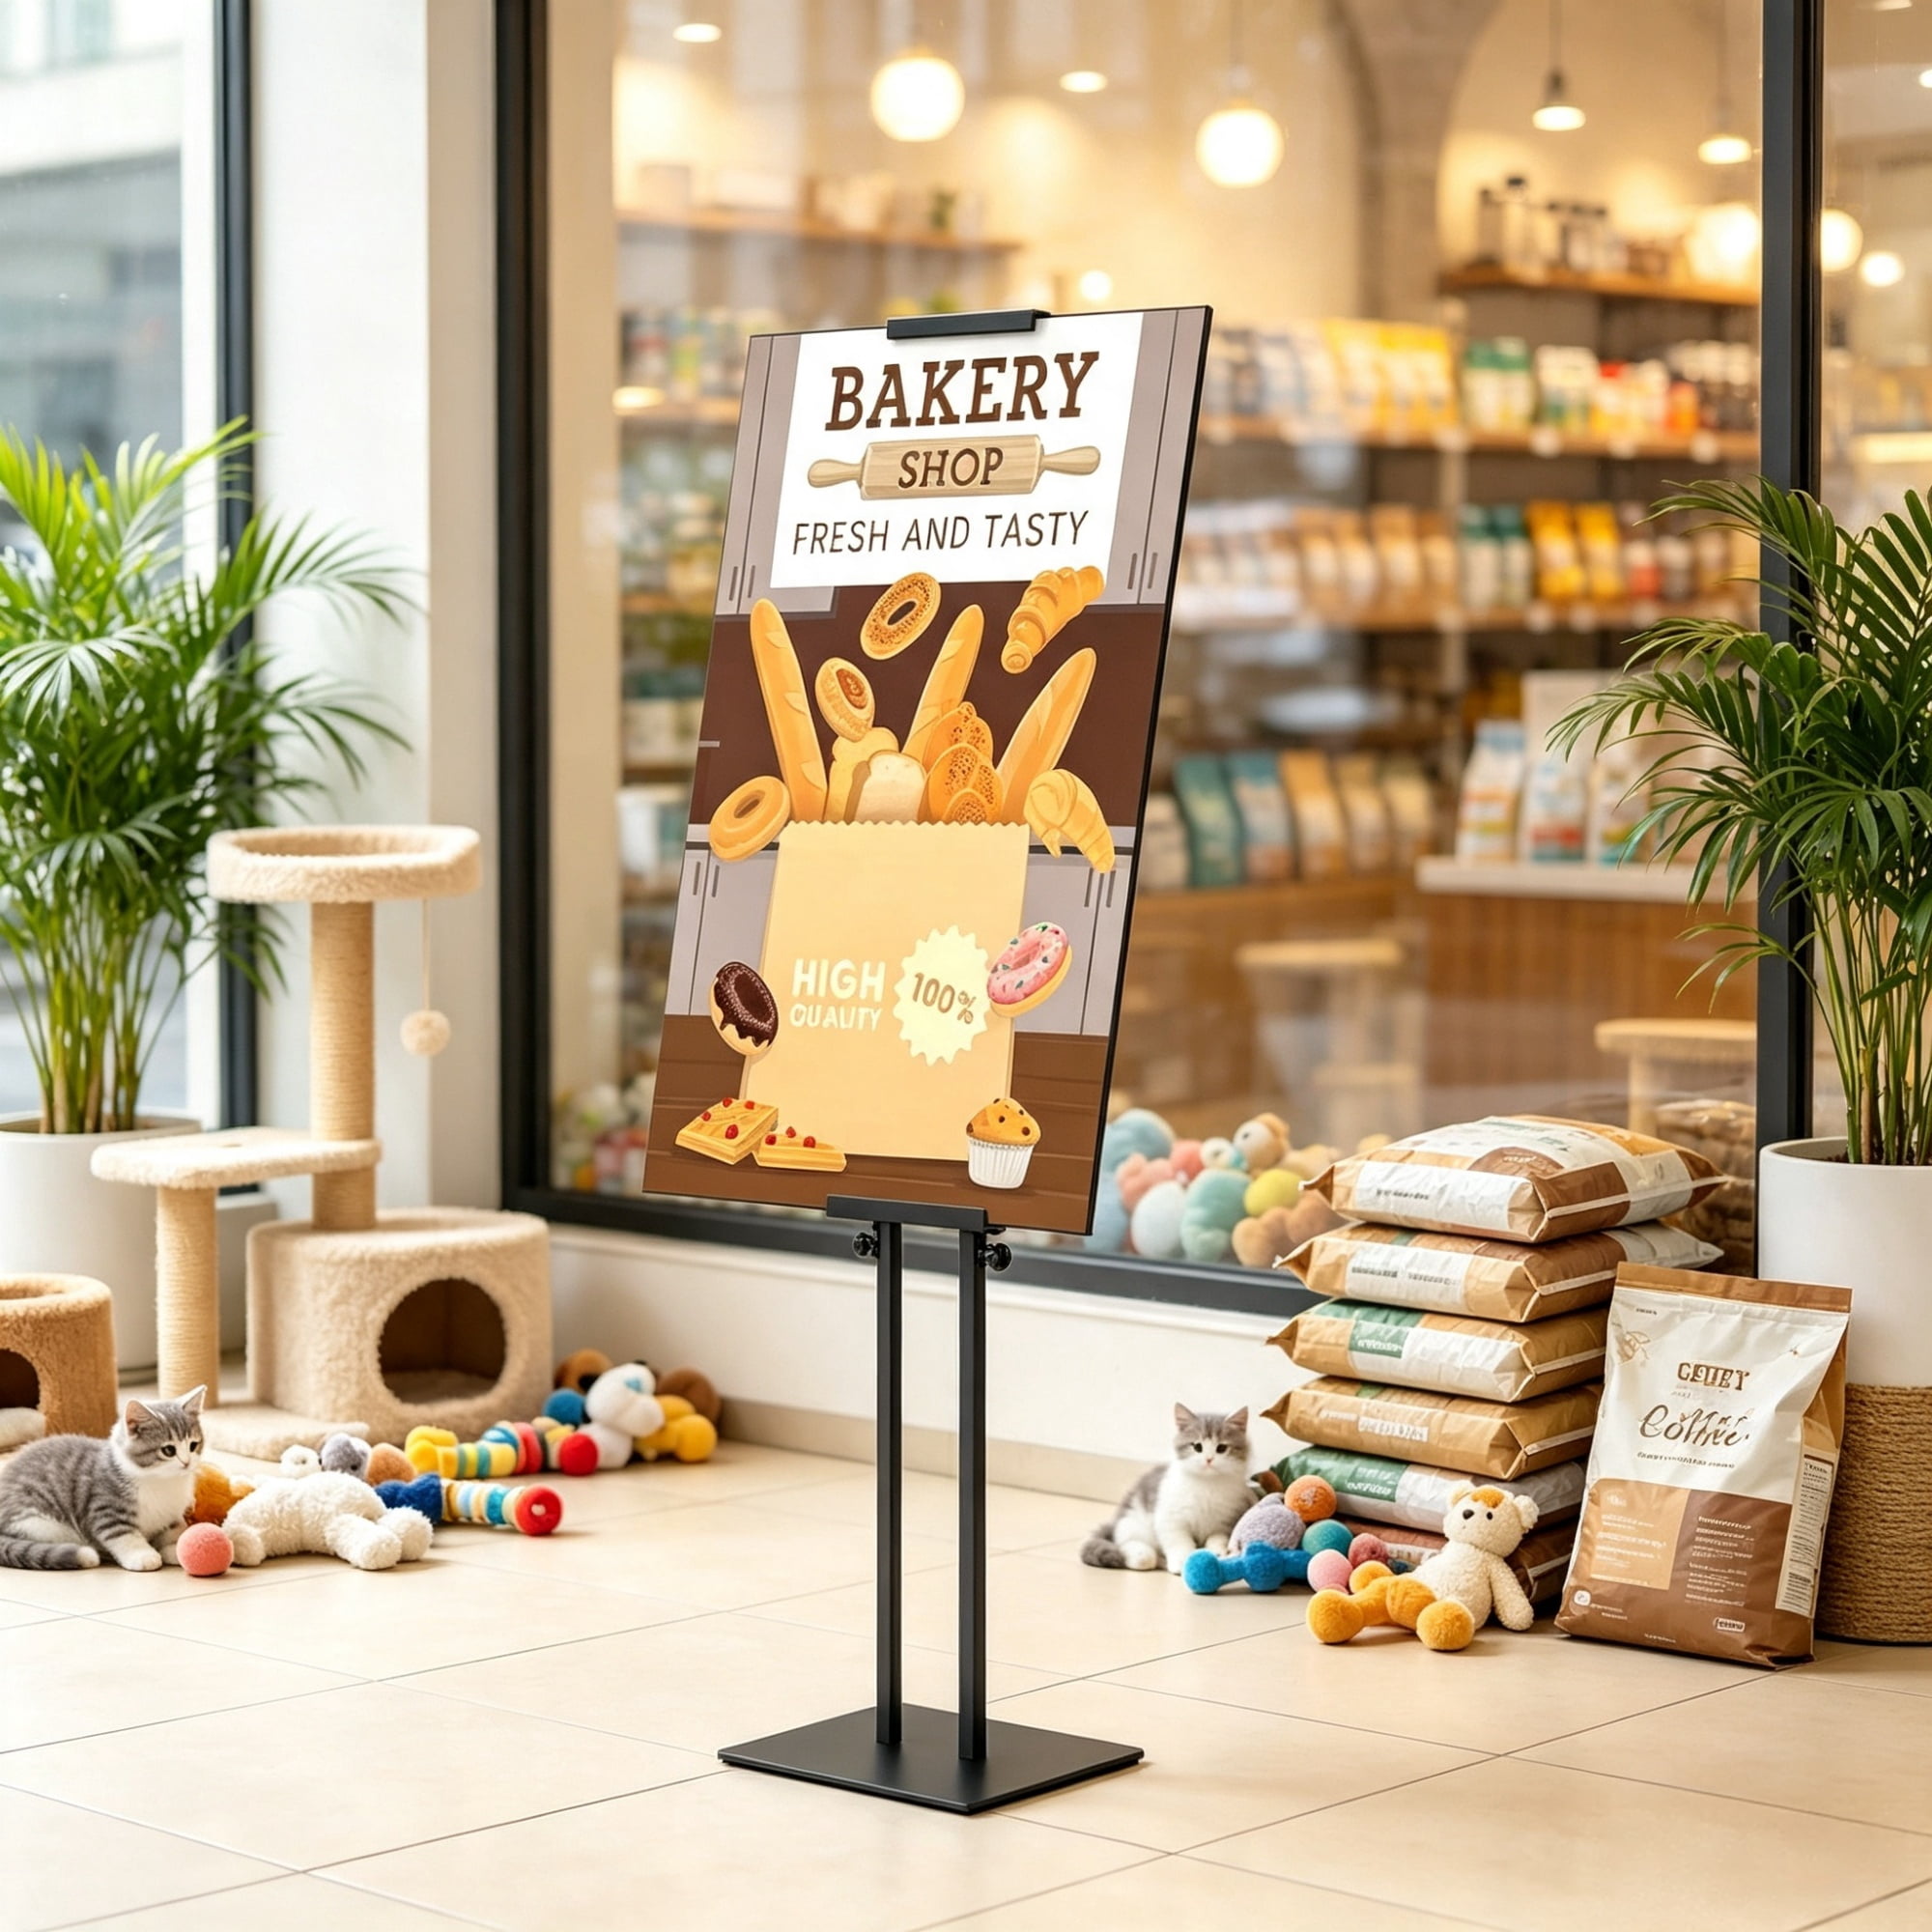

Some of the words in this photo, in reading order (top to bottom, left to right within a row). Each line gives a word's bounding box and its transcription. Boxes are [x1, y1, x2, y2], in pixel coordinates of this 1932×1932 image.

[825, 351, 1099, 431] BAKERY
[897, 446, 1004, 488] SHOP
[792, 520, 889, 554] FRESH
[901, 516, 970, 551] AND
[984, 510, 1089, 549] TASTY
[791, 958, 886, 1002] HIGH
[911, 972, 978, 1025] 100%
